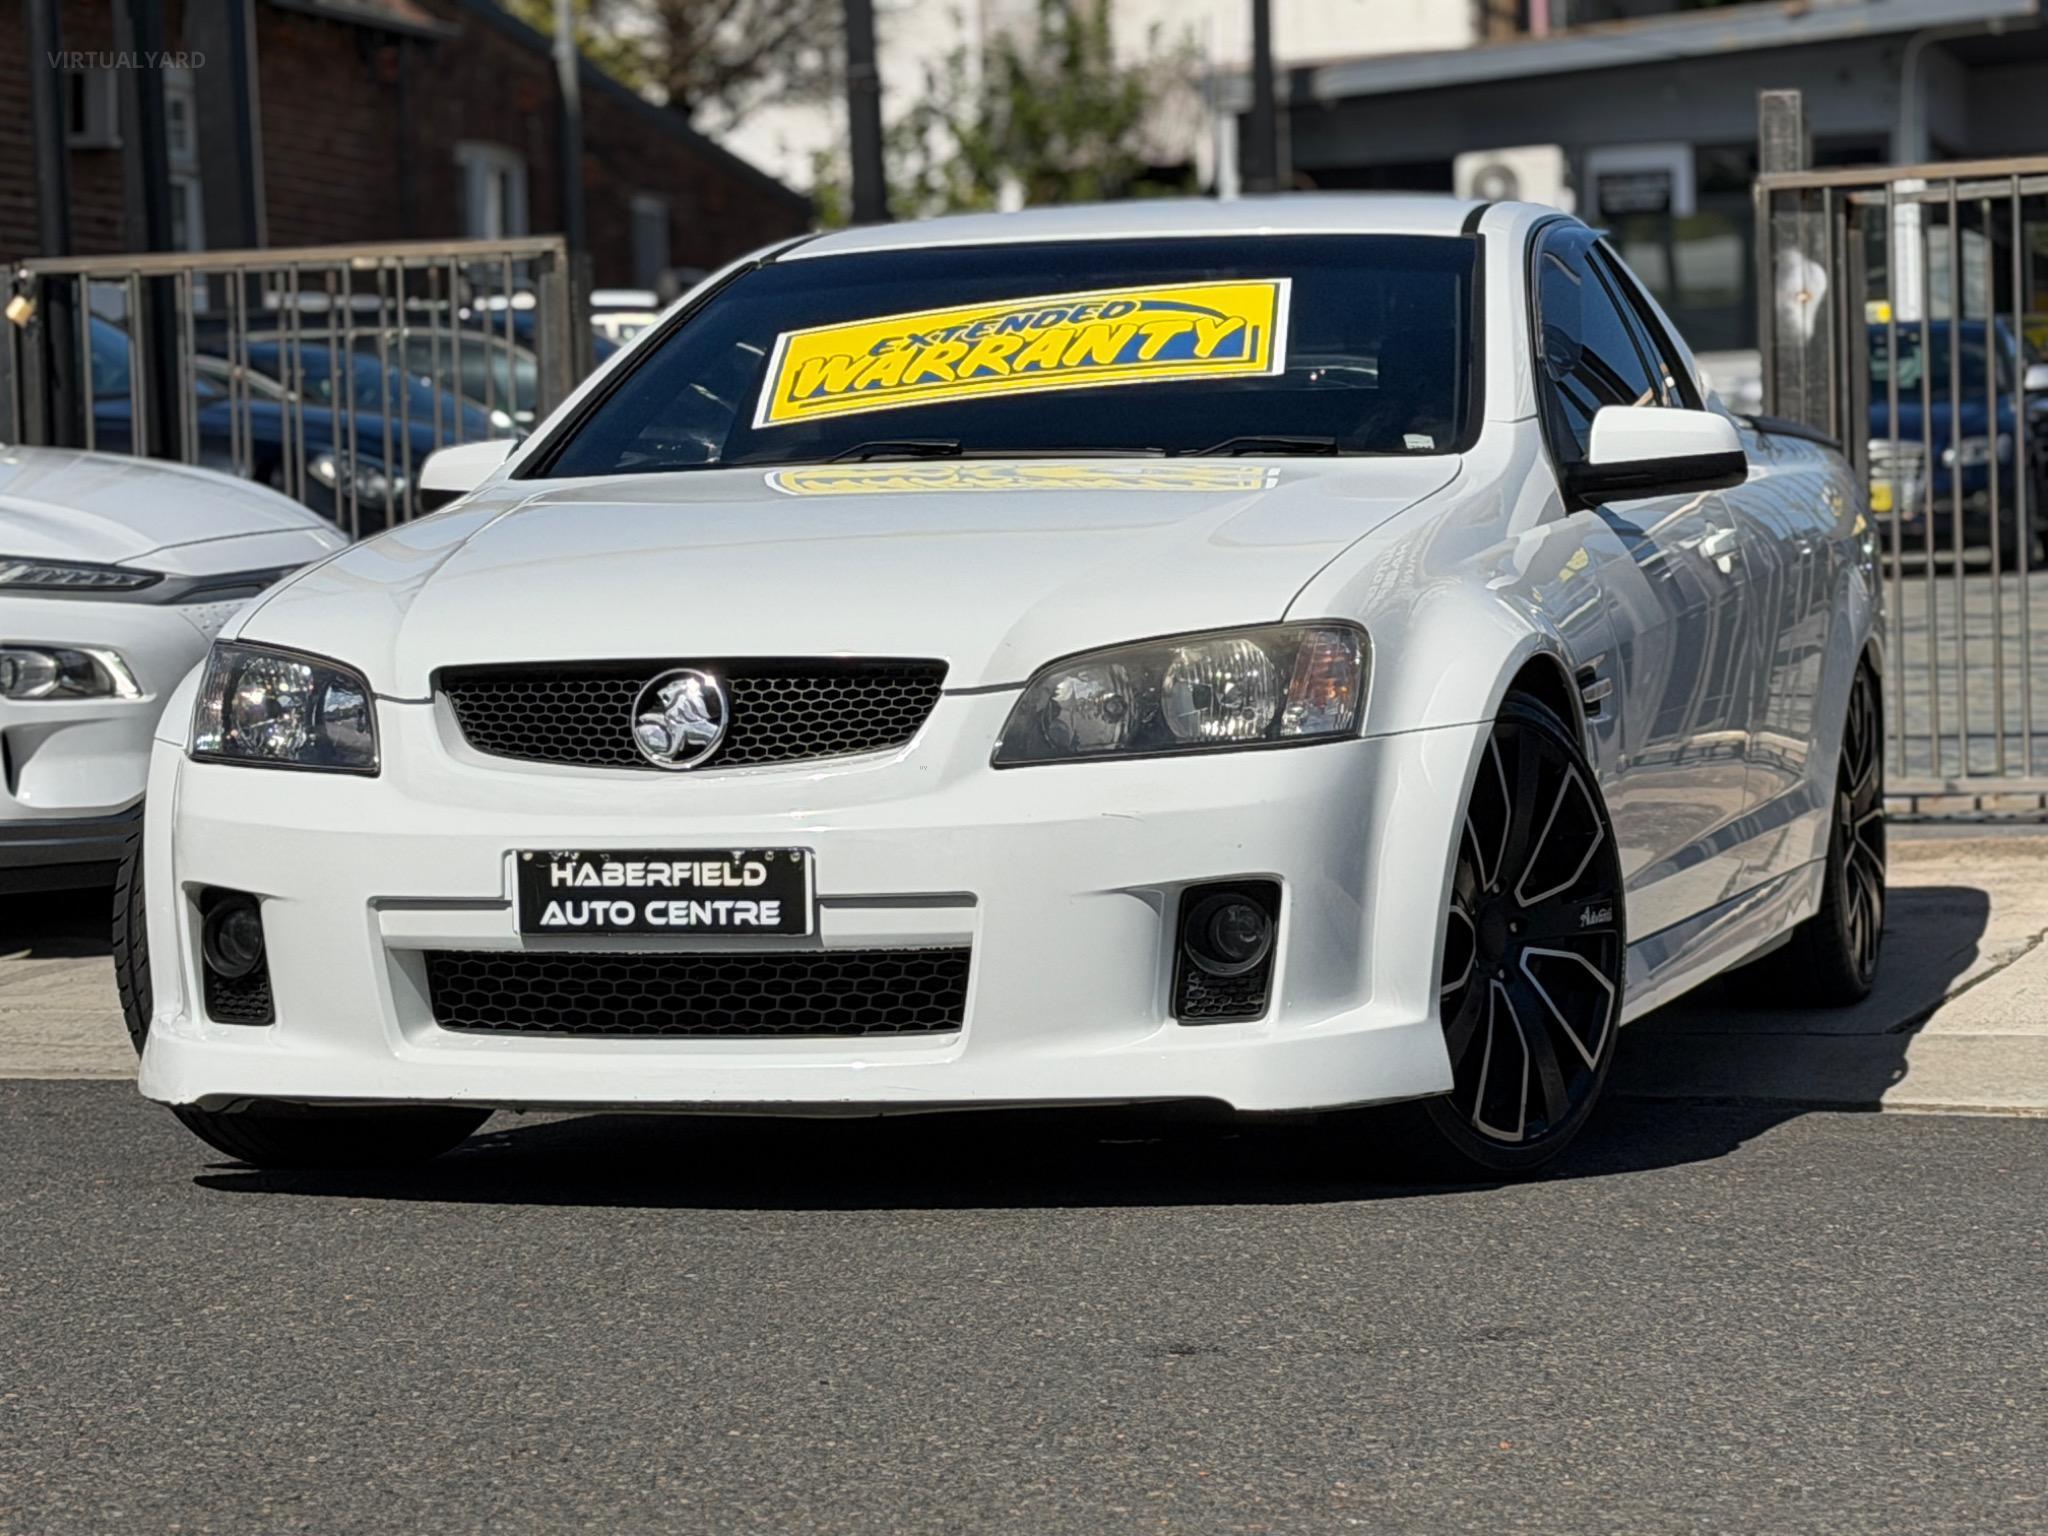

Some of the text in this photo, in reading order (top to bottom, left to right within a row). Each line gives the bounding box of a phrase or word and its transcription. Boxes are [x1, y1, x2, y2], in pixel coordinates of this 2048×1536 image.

[868, 301, 1140, 357] EXTENDED
[792, 316, 1247, 399] WARRANTY
[551, 862, 768, 887] HABERFIELD
[539, 900, 781, 926] AUTO CENTRE
